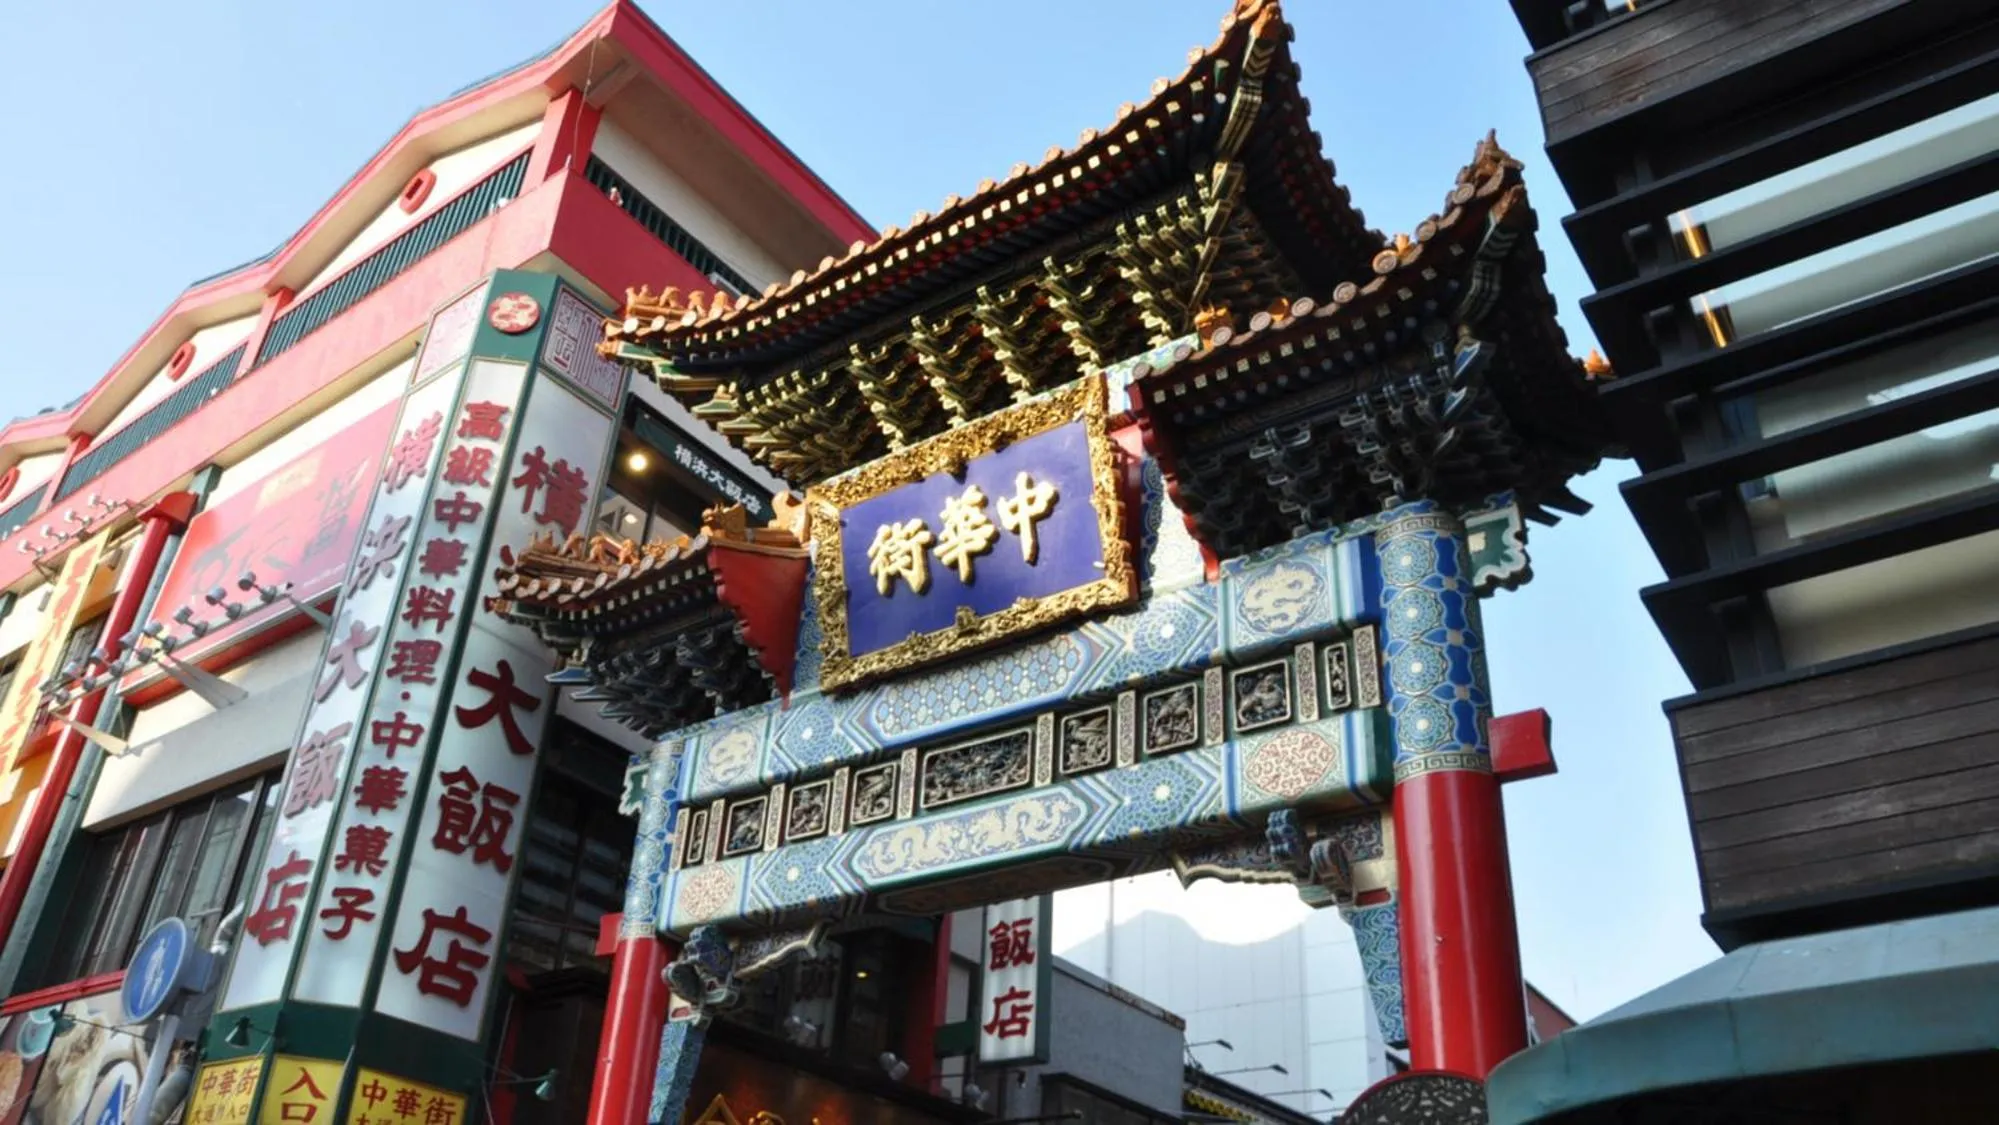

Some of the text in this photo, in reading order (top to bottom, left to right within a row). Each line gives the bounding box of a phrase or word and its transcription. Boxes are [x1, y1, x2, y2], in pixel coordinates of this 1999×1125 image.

[867, 471, 1057, 595] 中華街
[244, 410, 443, 947] 横浜大飯店
[320, 401, 508, 941] 高級中華料理・中華菓子
[393, 445, 589, 1009] 横大飯店
[983, 917, 1035, 1040] 飯店
[202, 1065, 258, 1099] 中華街
[280, 1066, 328, 1124] 入口
[362, 1079, 457, 1125] 中華街
